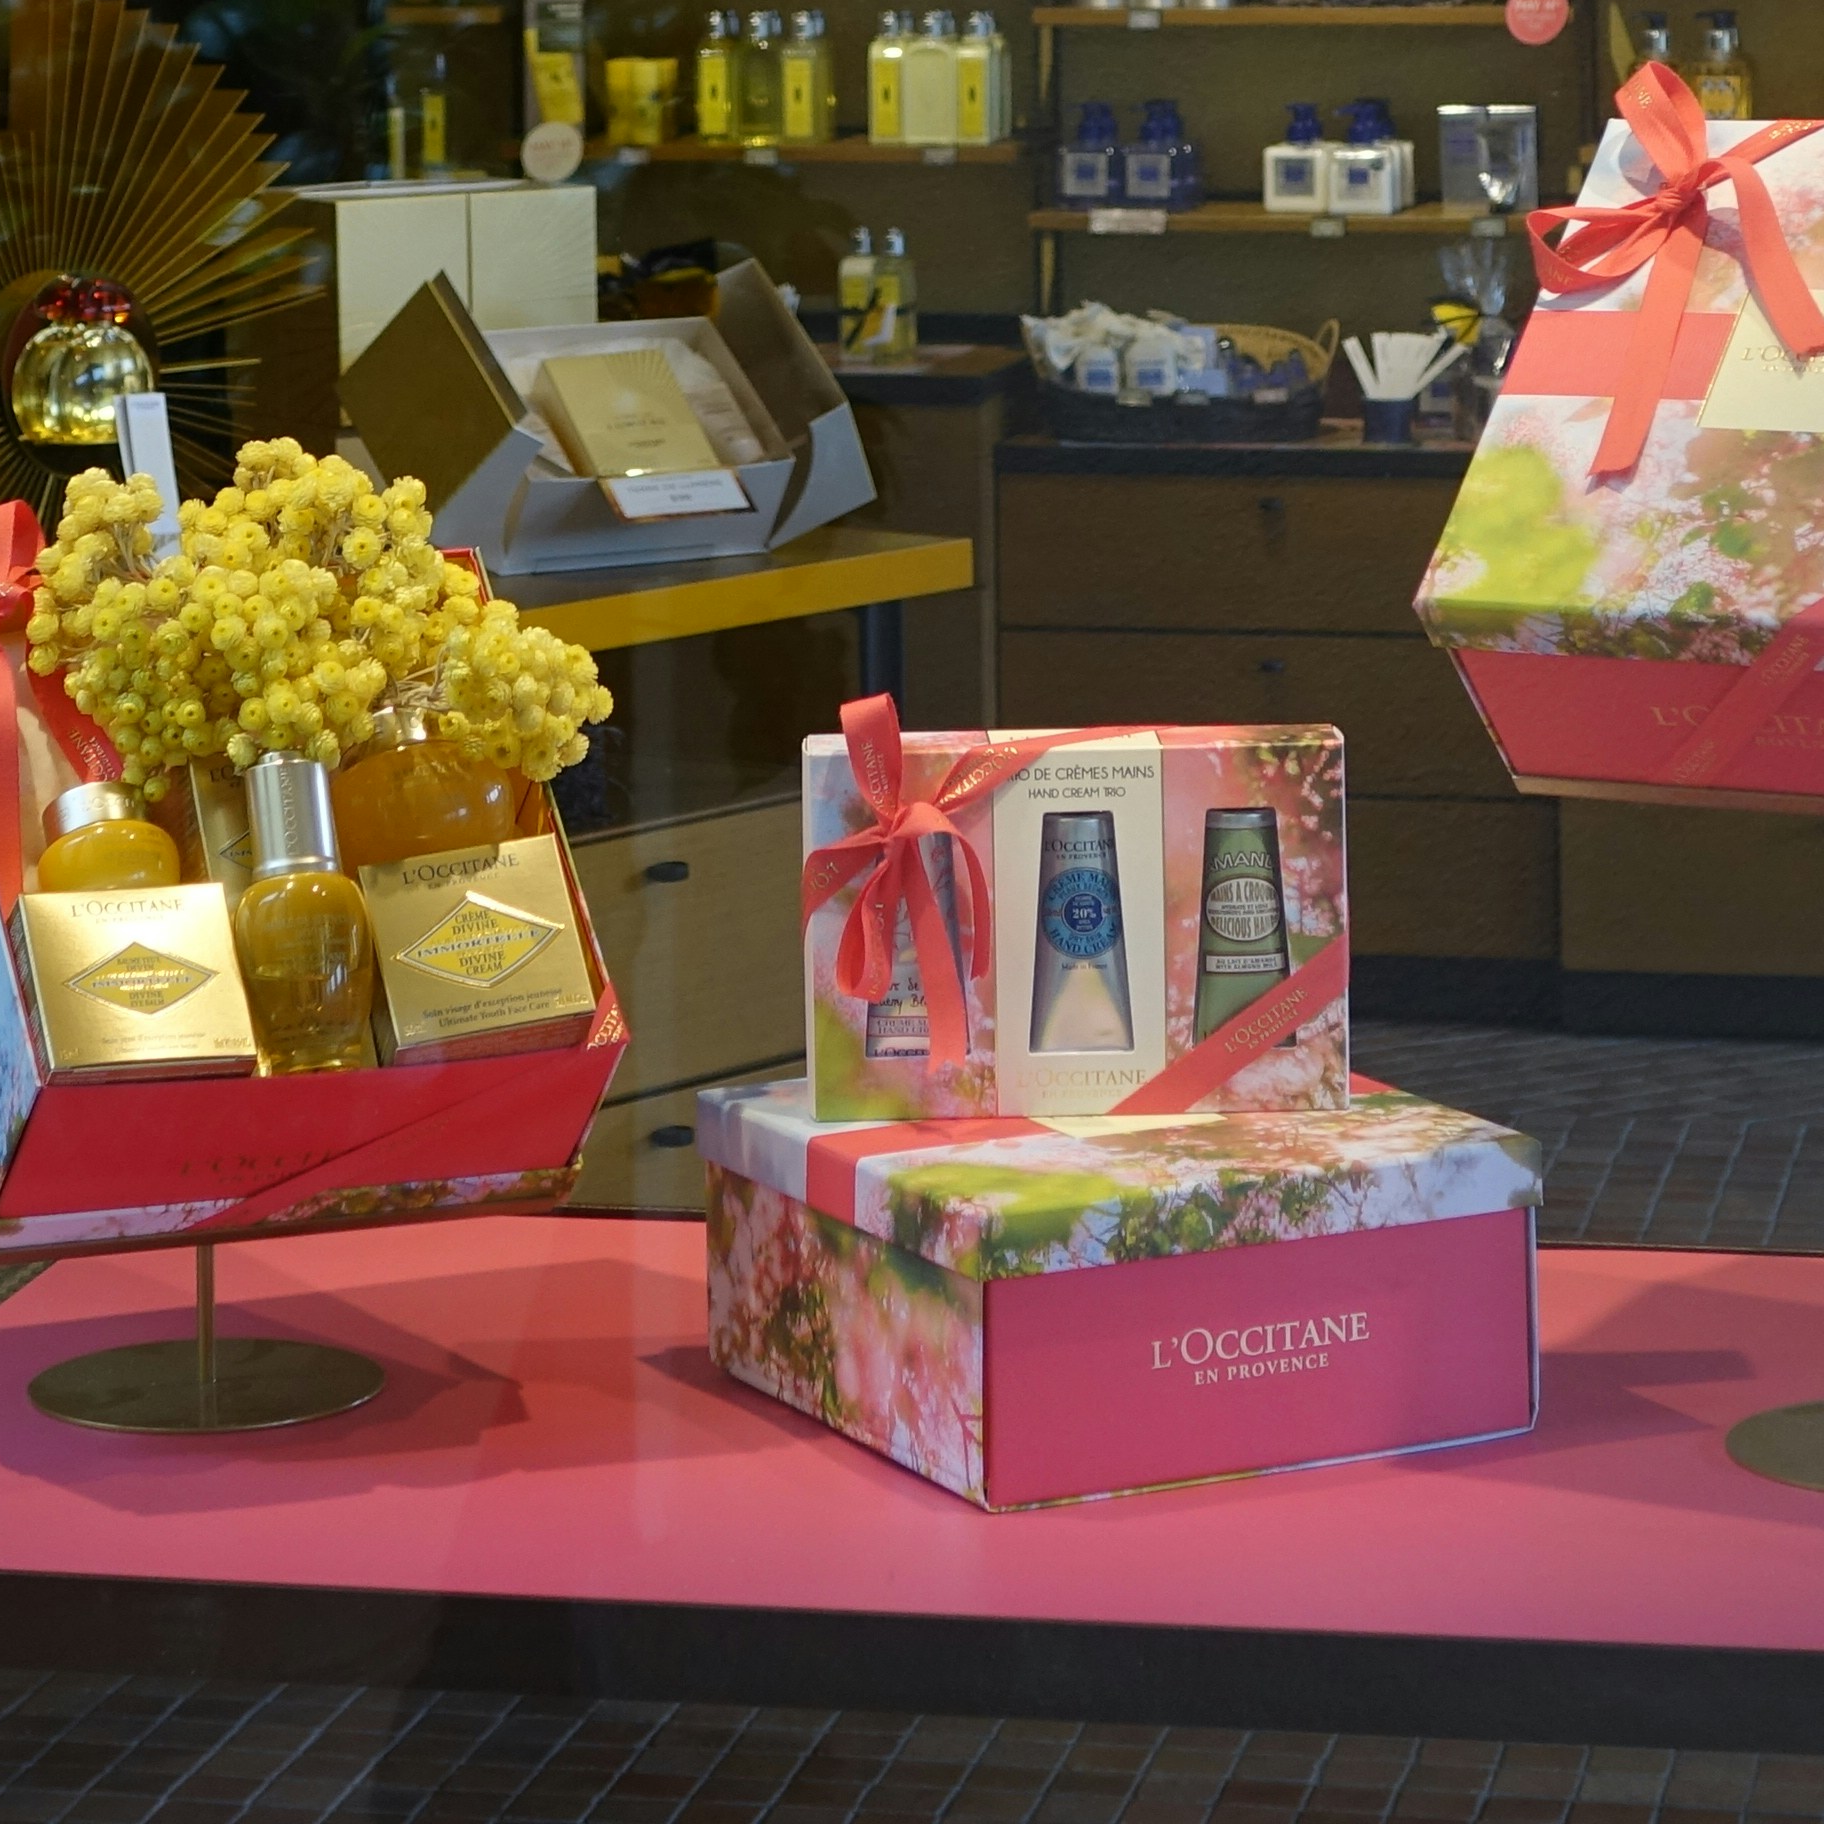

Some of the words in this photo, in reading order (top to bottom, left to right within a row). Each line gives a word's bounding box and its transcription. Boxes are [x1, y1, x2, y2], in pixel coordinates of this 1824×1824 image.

[1034, 767, 1051, 781] DE
[1055, 764, 1109, 782] CRÈMES
[1112, 765, 1155, 780] MAINS
[1028, 788, 1060, 800] HAND
[1062, 786, 1100, 799] CREAM
[1103, 786, 1127, 798] TRIO
[403, 853, 520, 886] L'OCCITANE
[71, 898, 186, 919] L'OCCITANE
[454, 909, 490, 924] CRÈME
[1072, 907, 1097, 920] 20%
[452, 918, 498, 936] DIVINE
[1210, 915, 1252, 939] DELICIOUS
[417, 929, 541, 958] IMMORTELLE
[1049, 927, 1082, 955] HAND
[458, 951, 506, 968] DIVINE
[465, 962, 503, 977] CREAM
[128, 990, 163, 1000] DIVINE
[438, 1014, 477, 1028] Ultimate
[478, 1009, 507, 1022] Youth
[507, 1004, 527, 1016] Face
[528, 1000, 550, 1012] Care
[1224, 985, 1310, 1054] L'OCCITANE
[1015, 1067, 1148, 1089] L'OCCITANE
[1151, 1311, 1371, 1371] L'OCCITANE
[1194, 1367, 1219, 1386] EN
[1226, 1352, 1330, 1382] PROVENCE
